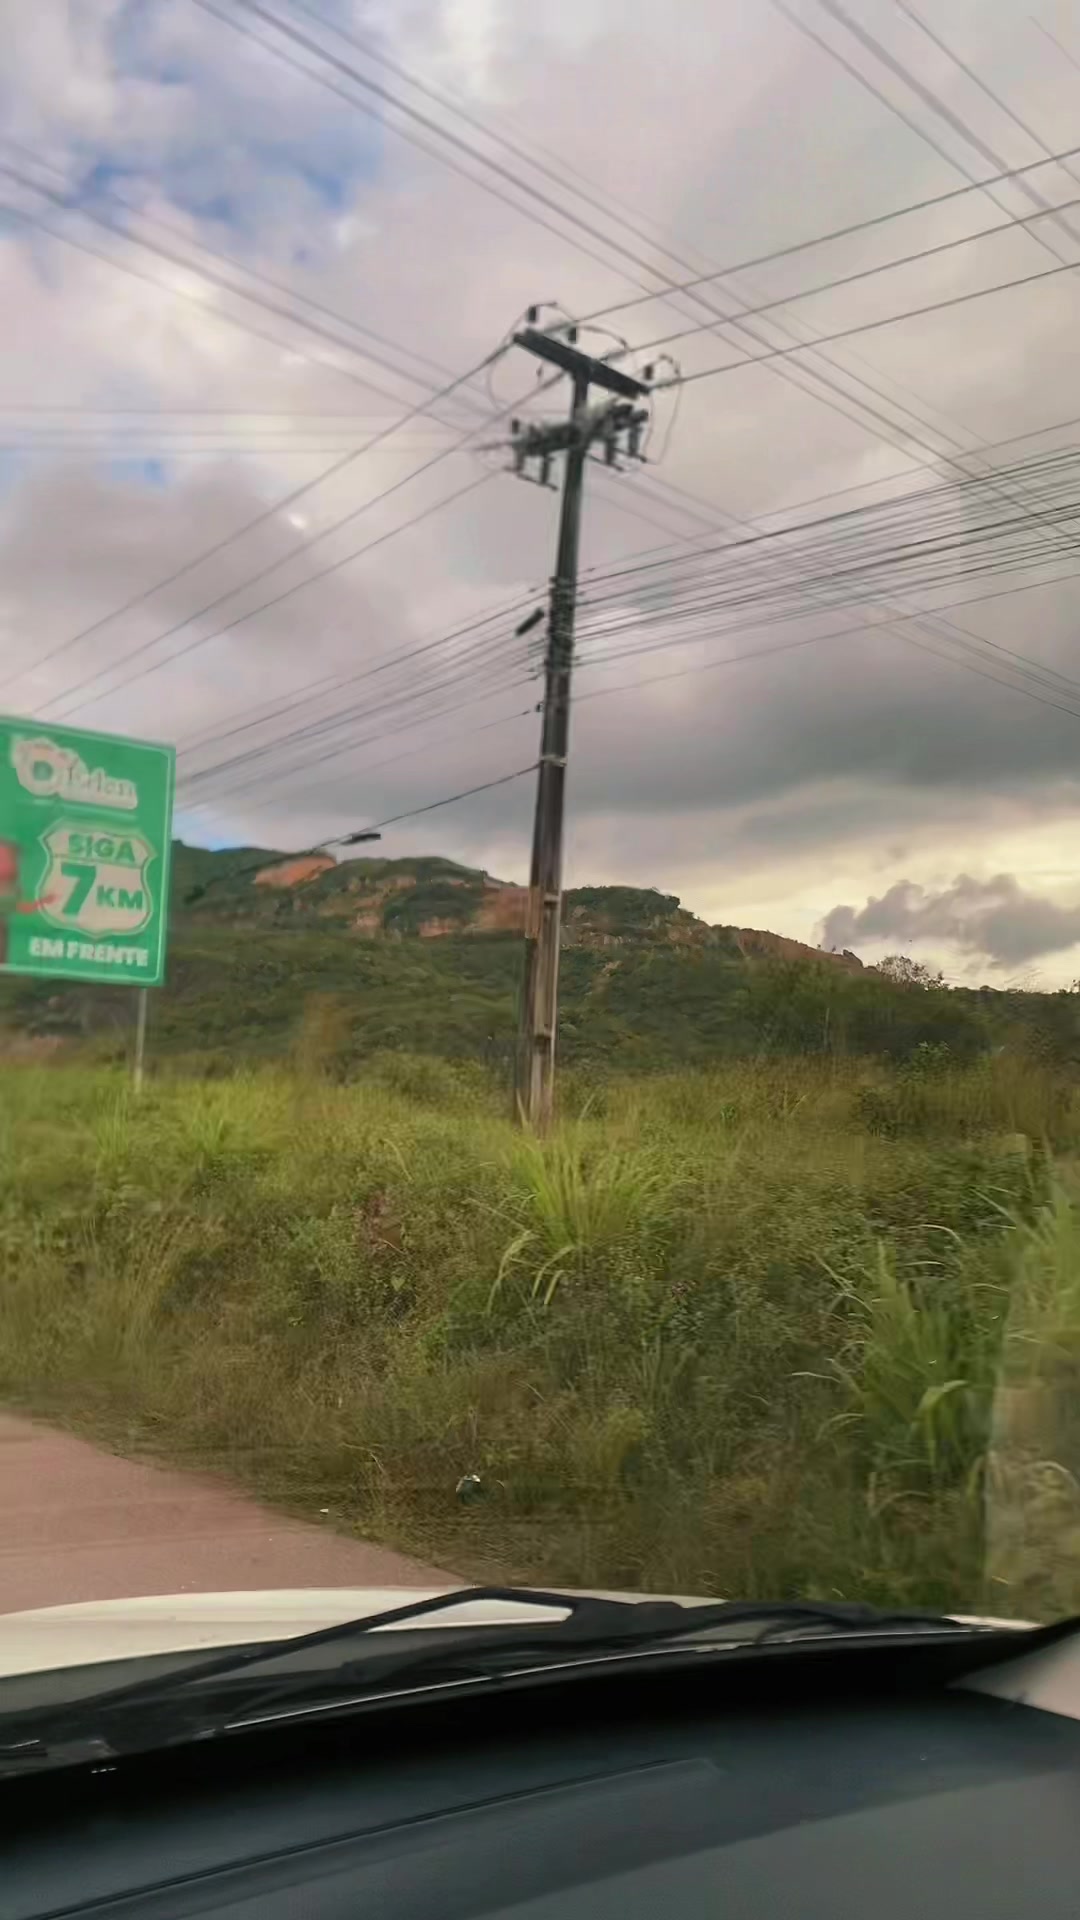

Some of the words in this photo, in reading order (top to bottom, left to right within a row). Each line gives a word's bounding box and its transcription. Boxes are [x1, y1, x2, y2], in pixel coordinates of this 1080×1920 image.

[68, 834, 136, 863] SIGA
[60, 862, 97, 916] 7
[96, 885, 144, 911] KM
[29, 936, 64, 958] EM
[66, 940, 149, 967] FRENTE
